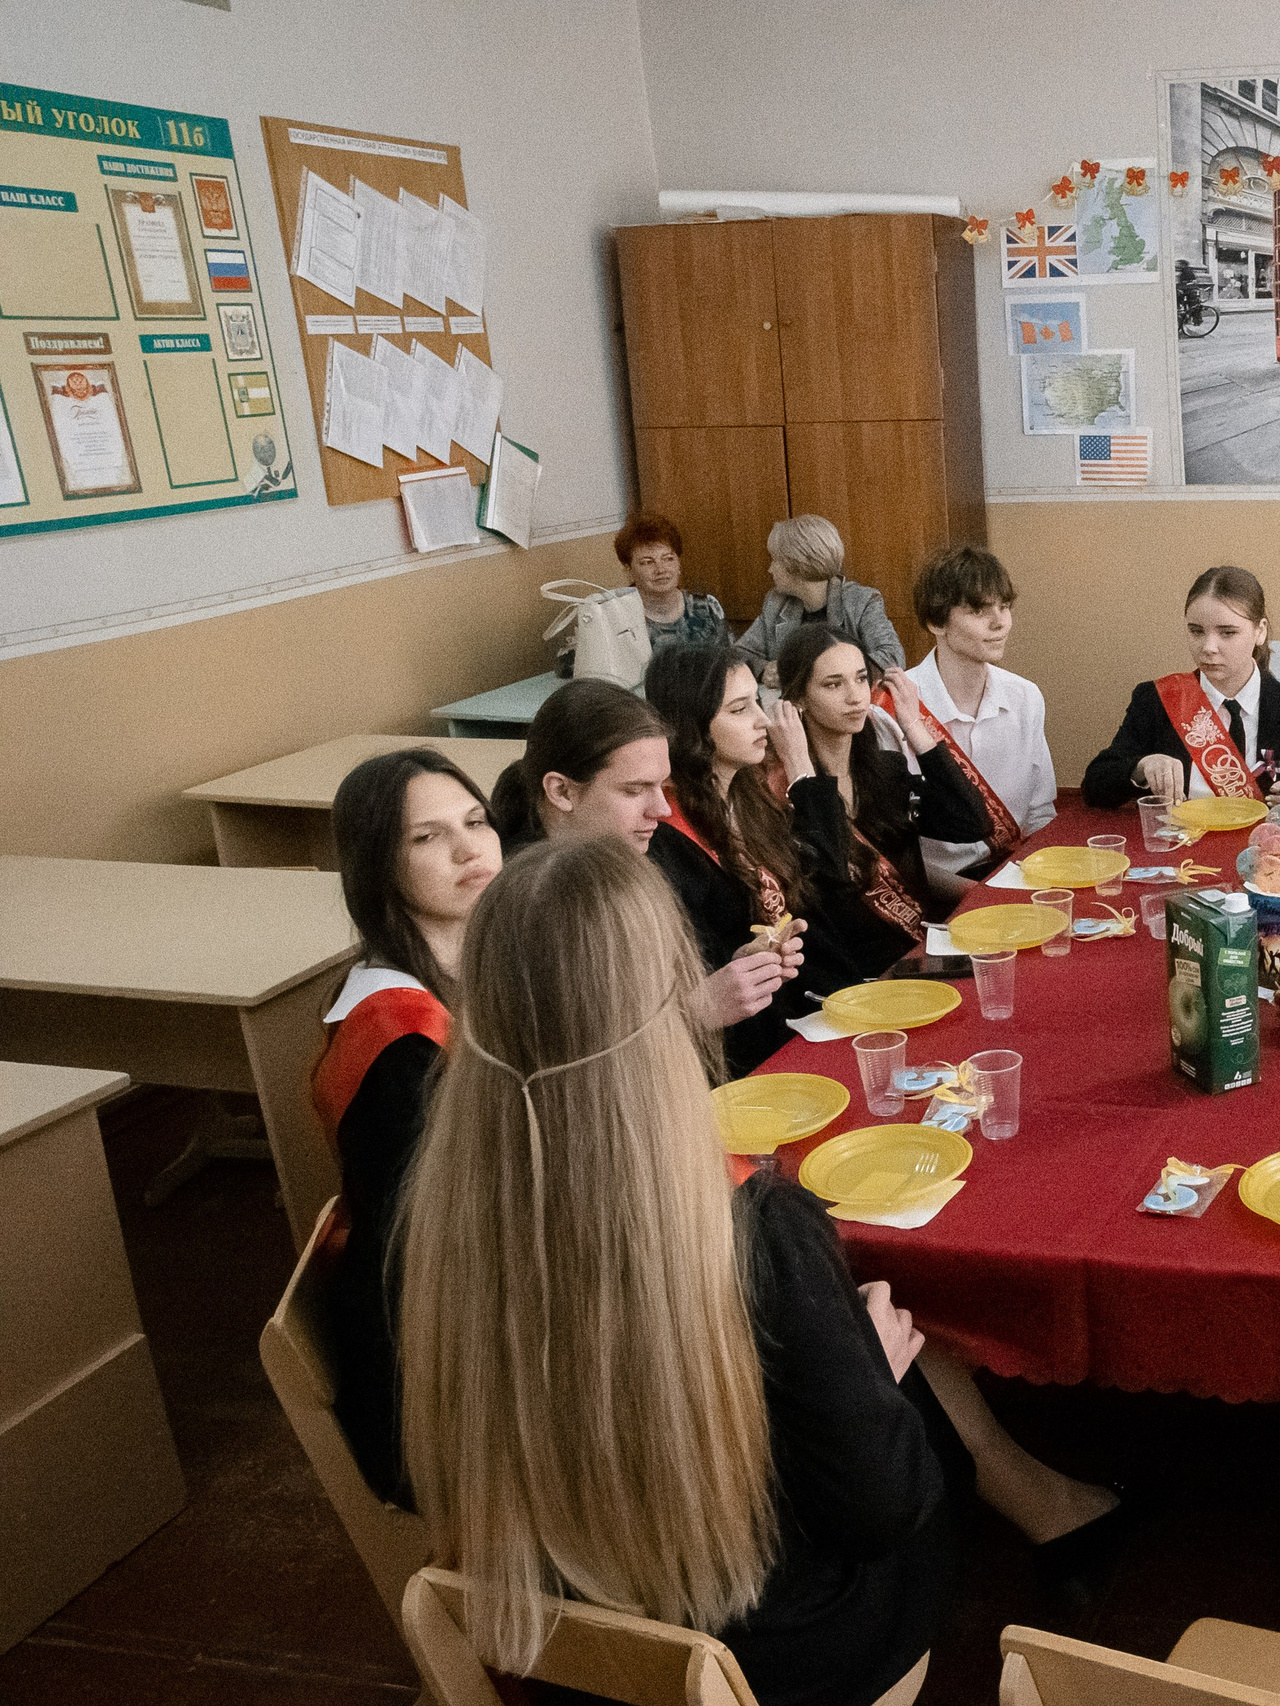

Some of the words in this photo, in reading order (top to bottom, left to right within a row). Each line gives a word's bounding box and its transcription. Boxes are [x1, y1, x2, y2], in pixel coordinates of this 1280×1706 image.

[51, 107, 141, 139] УГОЛОК
[166, 119, 205, 148] 11б
[1, 191, 28, 204] НАШ
[29, 194, 66, 207] КЛАСС
[28, 336, 105, 350] Поздравляем!
[1171, 922, 1204, 957] Добрый
